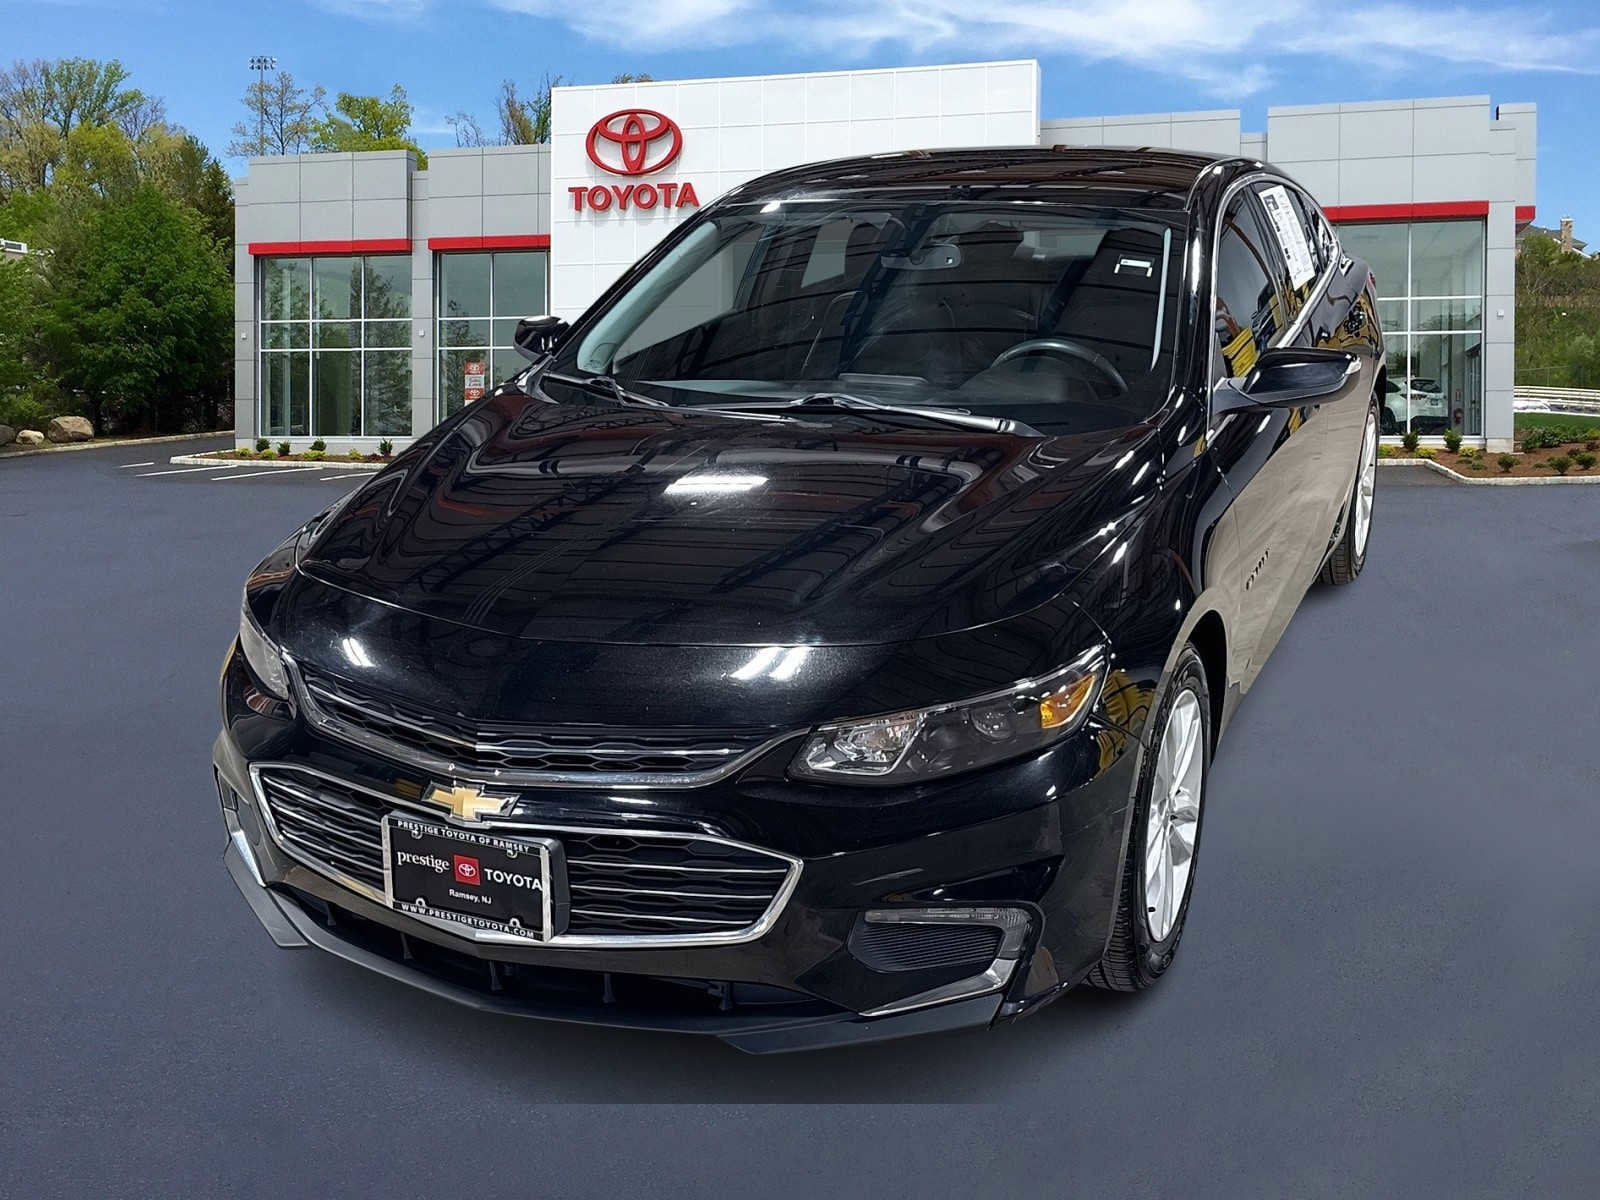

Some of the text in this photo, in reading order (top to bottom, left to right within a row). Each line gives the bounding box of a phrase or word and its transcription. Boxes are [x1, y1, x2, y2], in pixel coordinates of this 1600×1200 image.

[568, 182, 700, 212] TOYOTA
[397, 820, 529, 853] PRESTIGE TOYOTA OF RAMSEY
[397, 851, 543, 891] prestige TOYOTA
[481, 895, 492, 904] NJ
[401, 903, 534, 938] WWW.PRESTIGETOYOTA.COM
